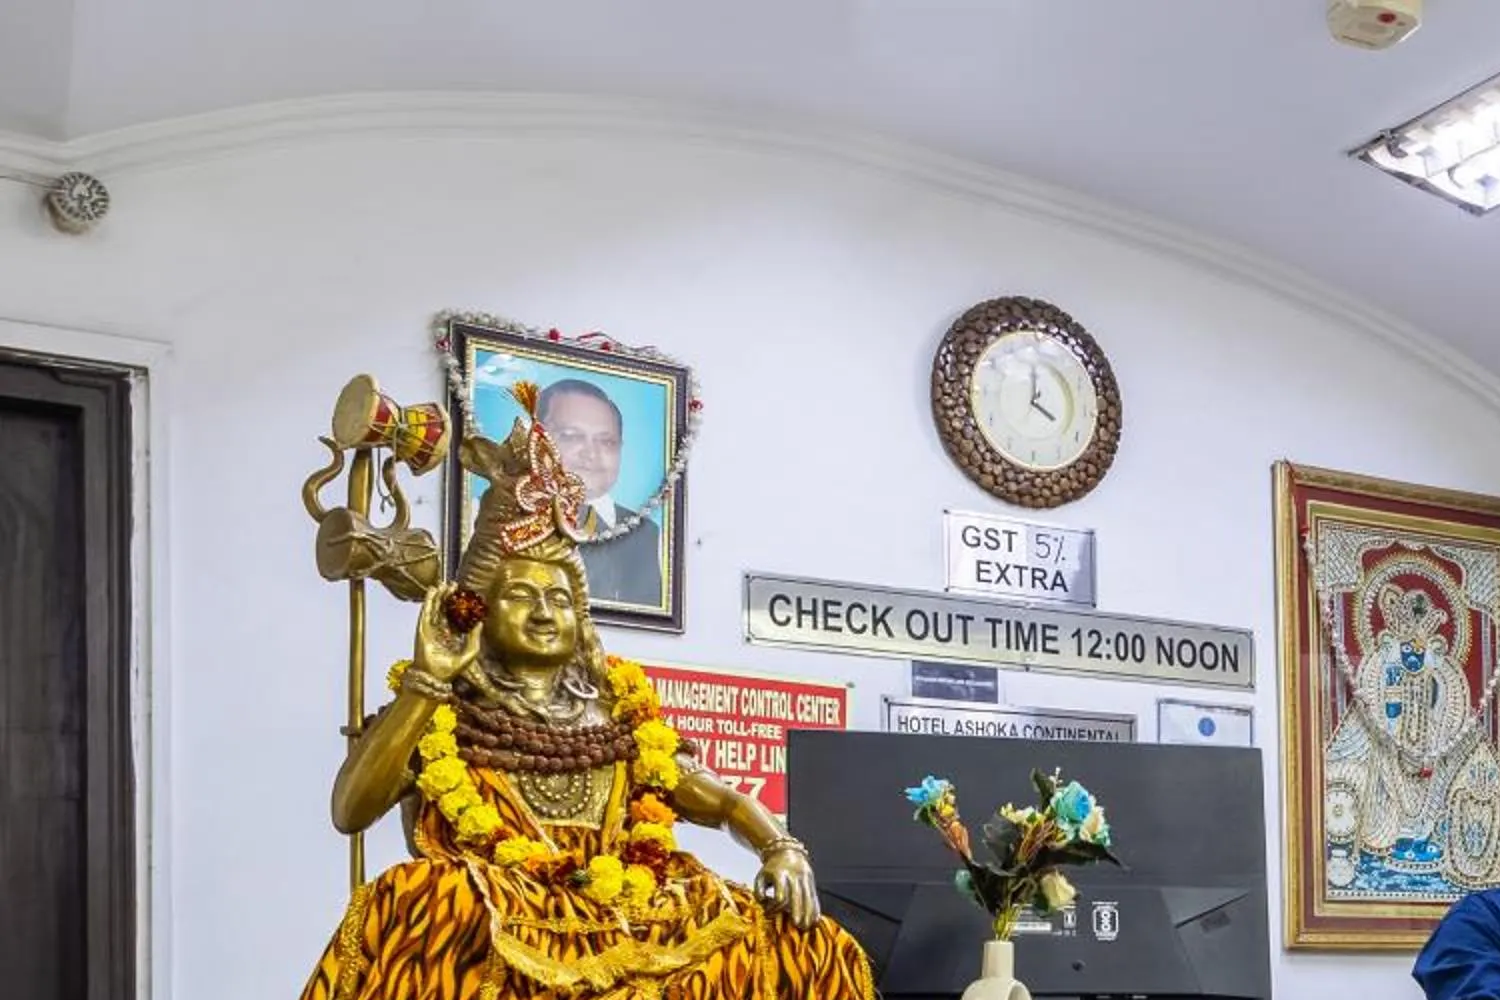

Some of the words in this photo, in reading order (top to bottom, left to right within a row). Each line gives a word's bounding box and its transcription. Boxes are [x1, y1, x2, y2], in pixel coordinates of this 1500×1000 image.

[961, 525, 1018, 553] GST
[1035, 533, 1067, 564] 5%
[976, 560, 1069, 593] EXTRA
[769, 593, 894, 638] CHECK
[905, 608, 975, 646] OUT
[984, 616, 1060, 656] TIME
[1071, 627, 1146, 664] 12:00
[1156, 636, 1240, 673] NOON
[658, 679, 740, 714] MANAGEMENT
[741, 687, 794, 721] CONTROL
[797, 694, 841, 725] CENTER
[677, 715, 713, 733] HOUR
[717, 718, 783, 740] TOLL-FREE
[898, 714, 951, 736] HOTEL
[953, 718, 1019, 738] ASHOKA
[715, 739, 757, 771] HELP
[761, 744, 787, 774] LIN
